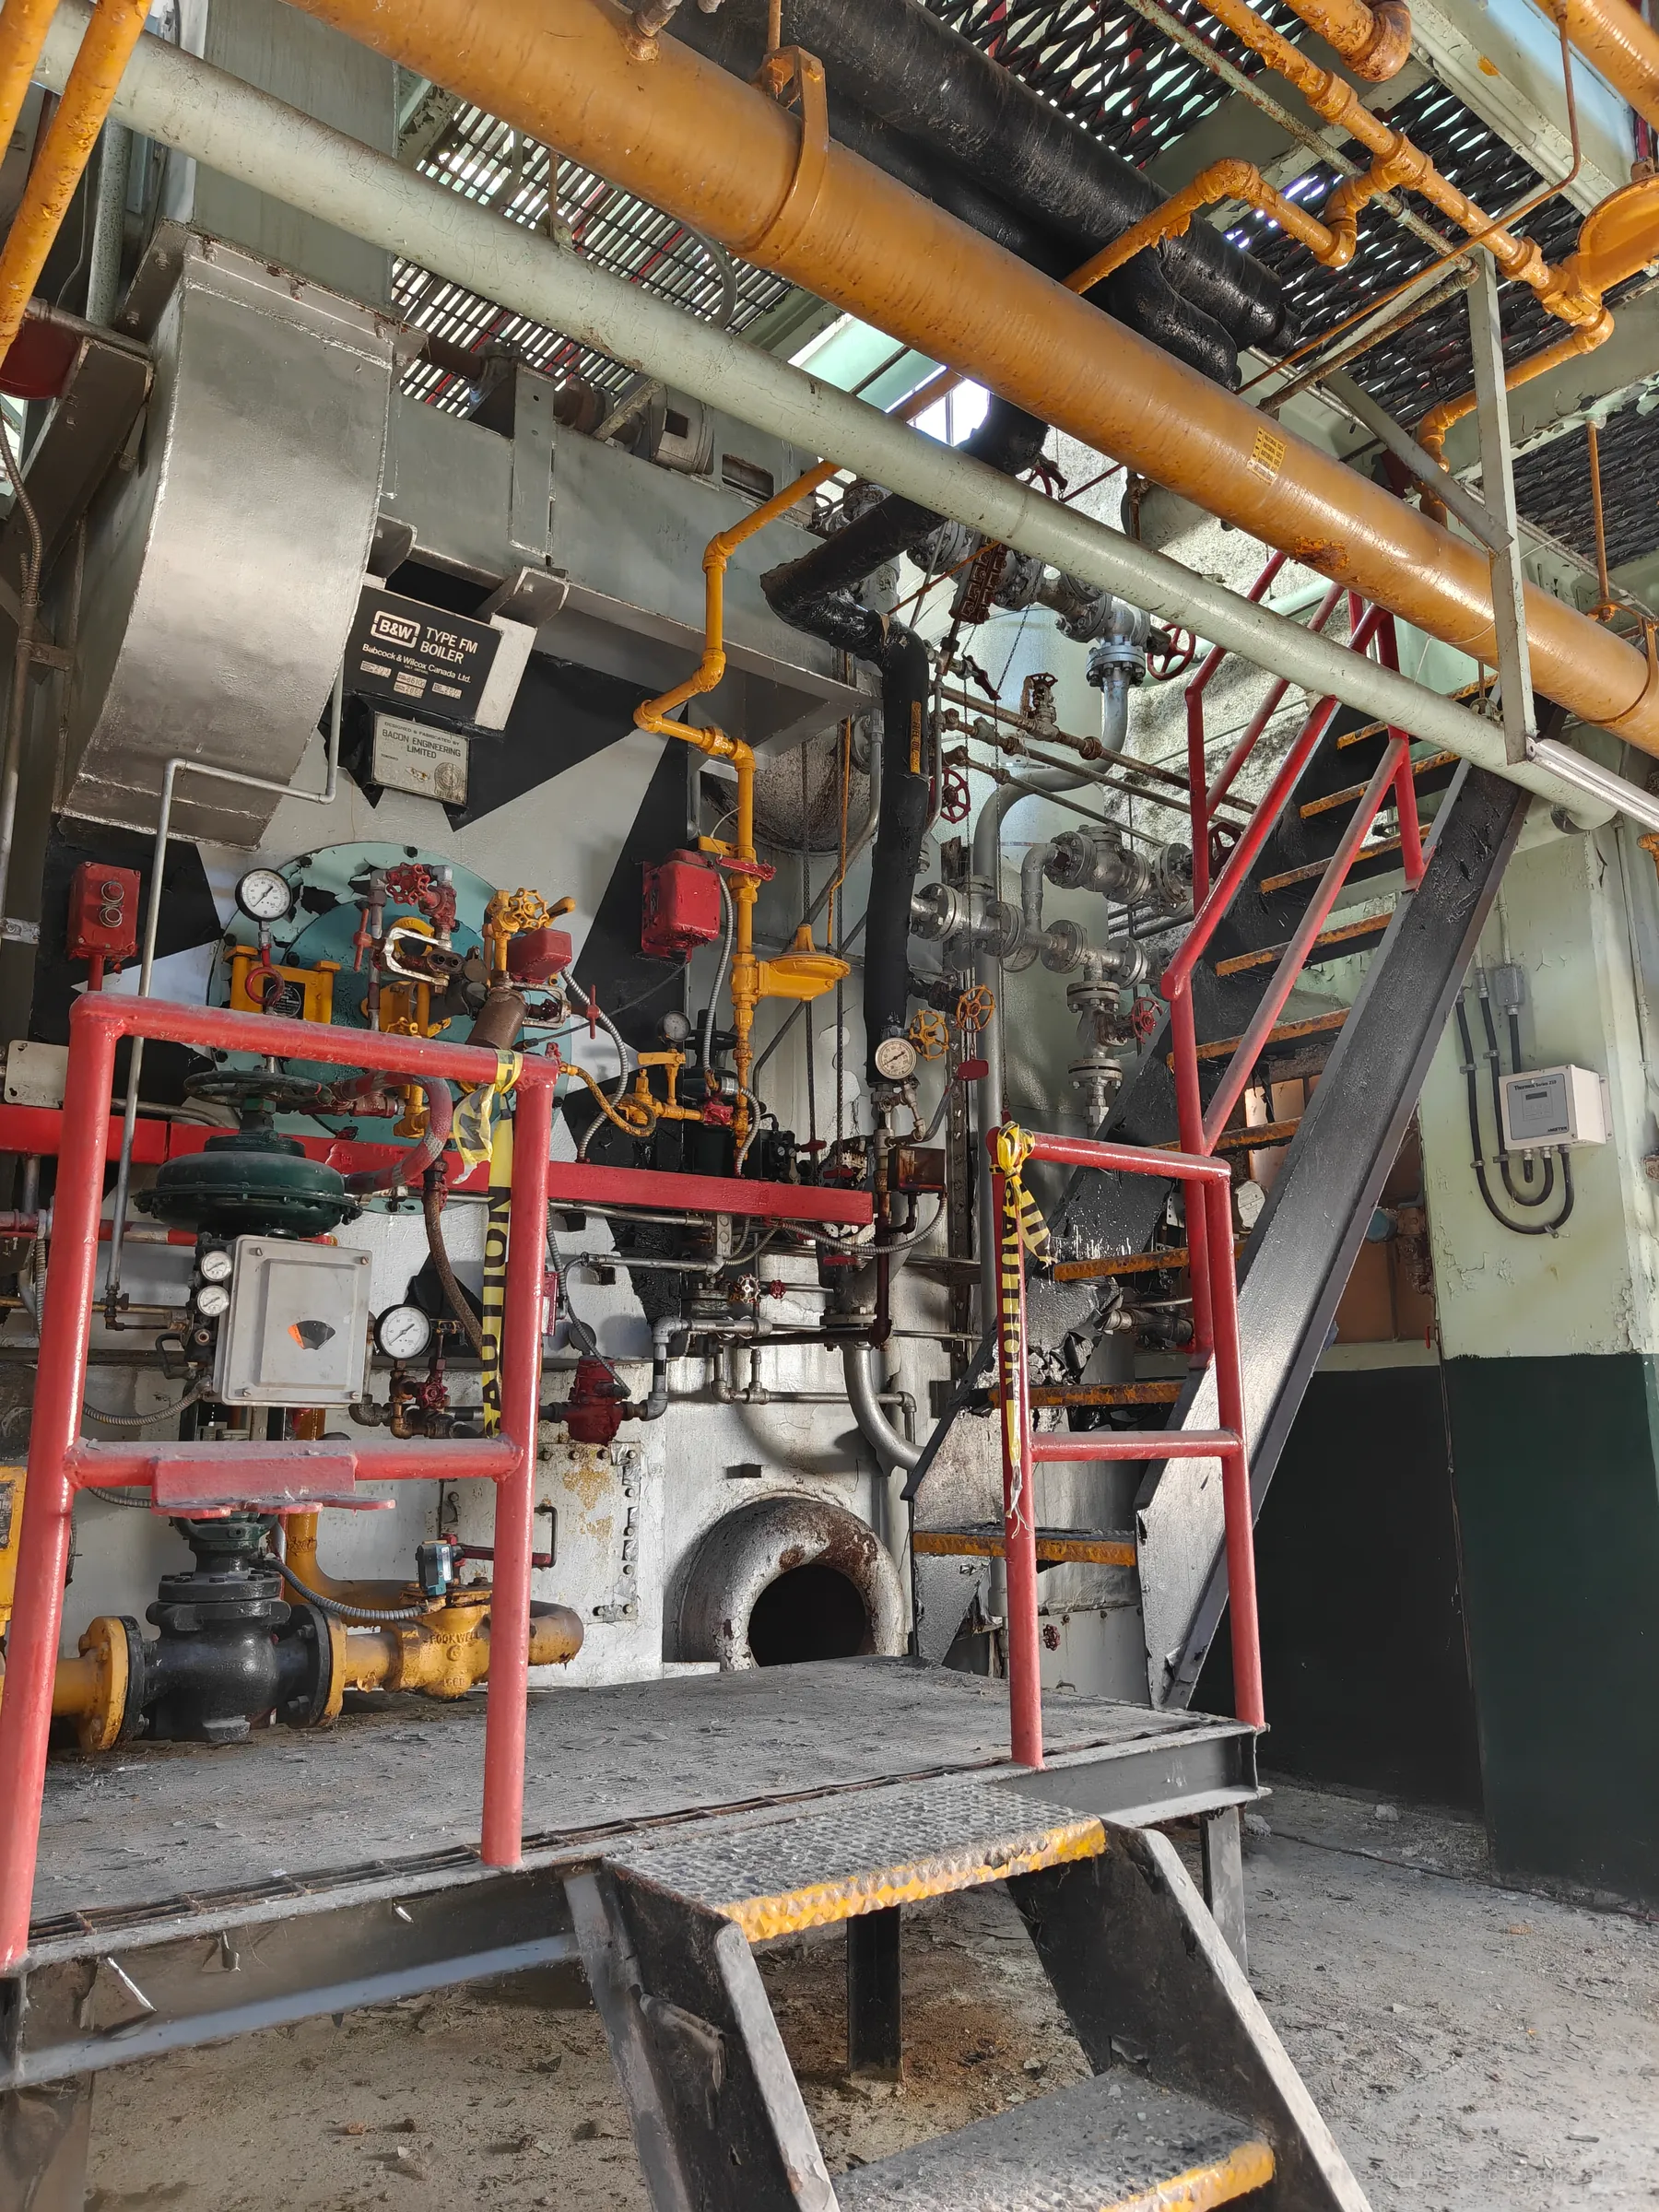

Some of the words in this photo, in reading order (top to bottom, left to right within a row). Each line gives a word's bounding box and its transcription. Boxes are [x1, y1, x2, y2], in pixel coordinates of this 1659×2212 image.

[379, 618, 413, 640] B&W
[426, 627, 458, 647] TYPE
[459, 638, 478, 654] FM
[362, 643, 396, 660] Babcock
[403, 655, 427, 670] Wilcox
[428, 664, 456, 678] Canada
[457, 673, 472, 684] Ltd.
[419, 641, 465, 665] BOILER
[384, 722, 412, 733] DESIGNED
[418, 731, 452, 744] FABRICATED
[912, 721, 921, 738] FUEL
[382, 729, 410, 743] BACON
[412, 737, 461, 758] ENGINEERING
[406, 745, 437, 759] LIMITED
[912, 739, 920, 753] OIL
